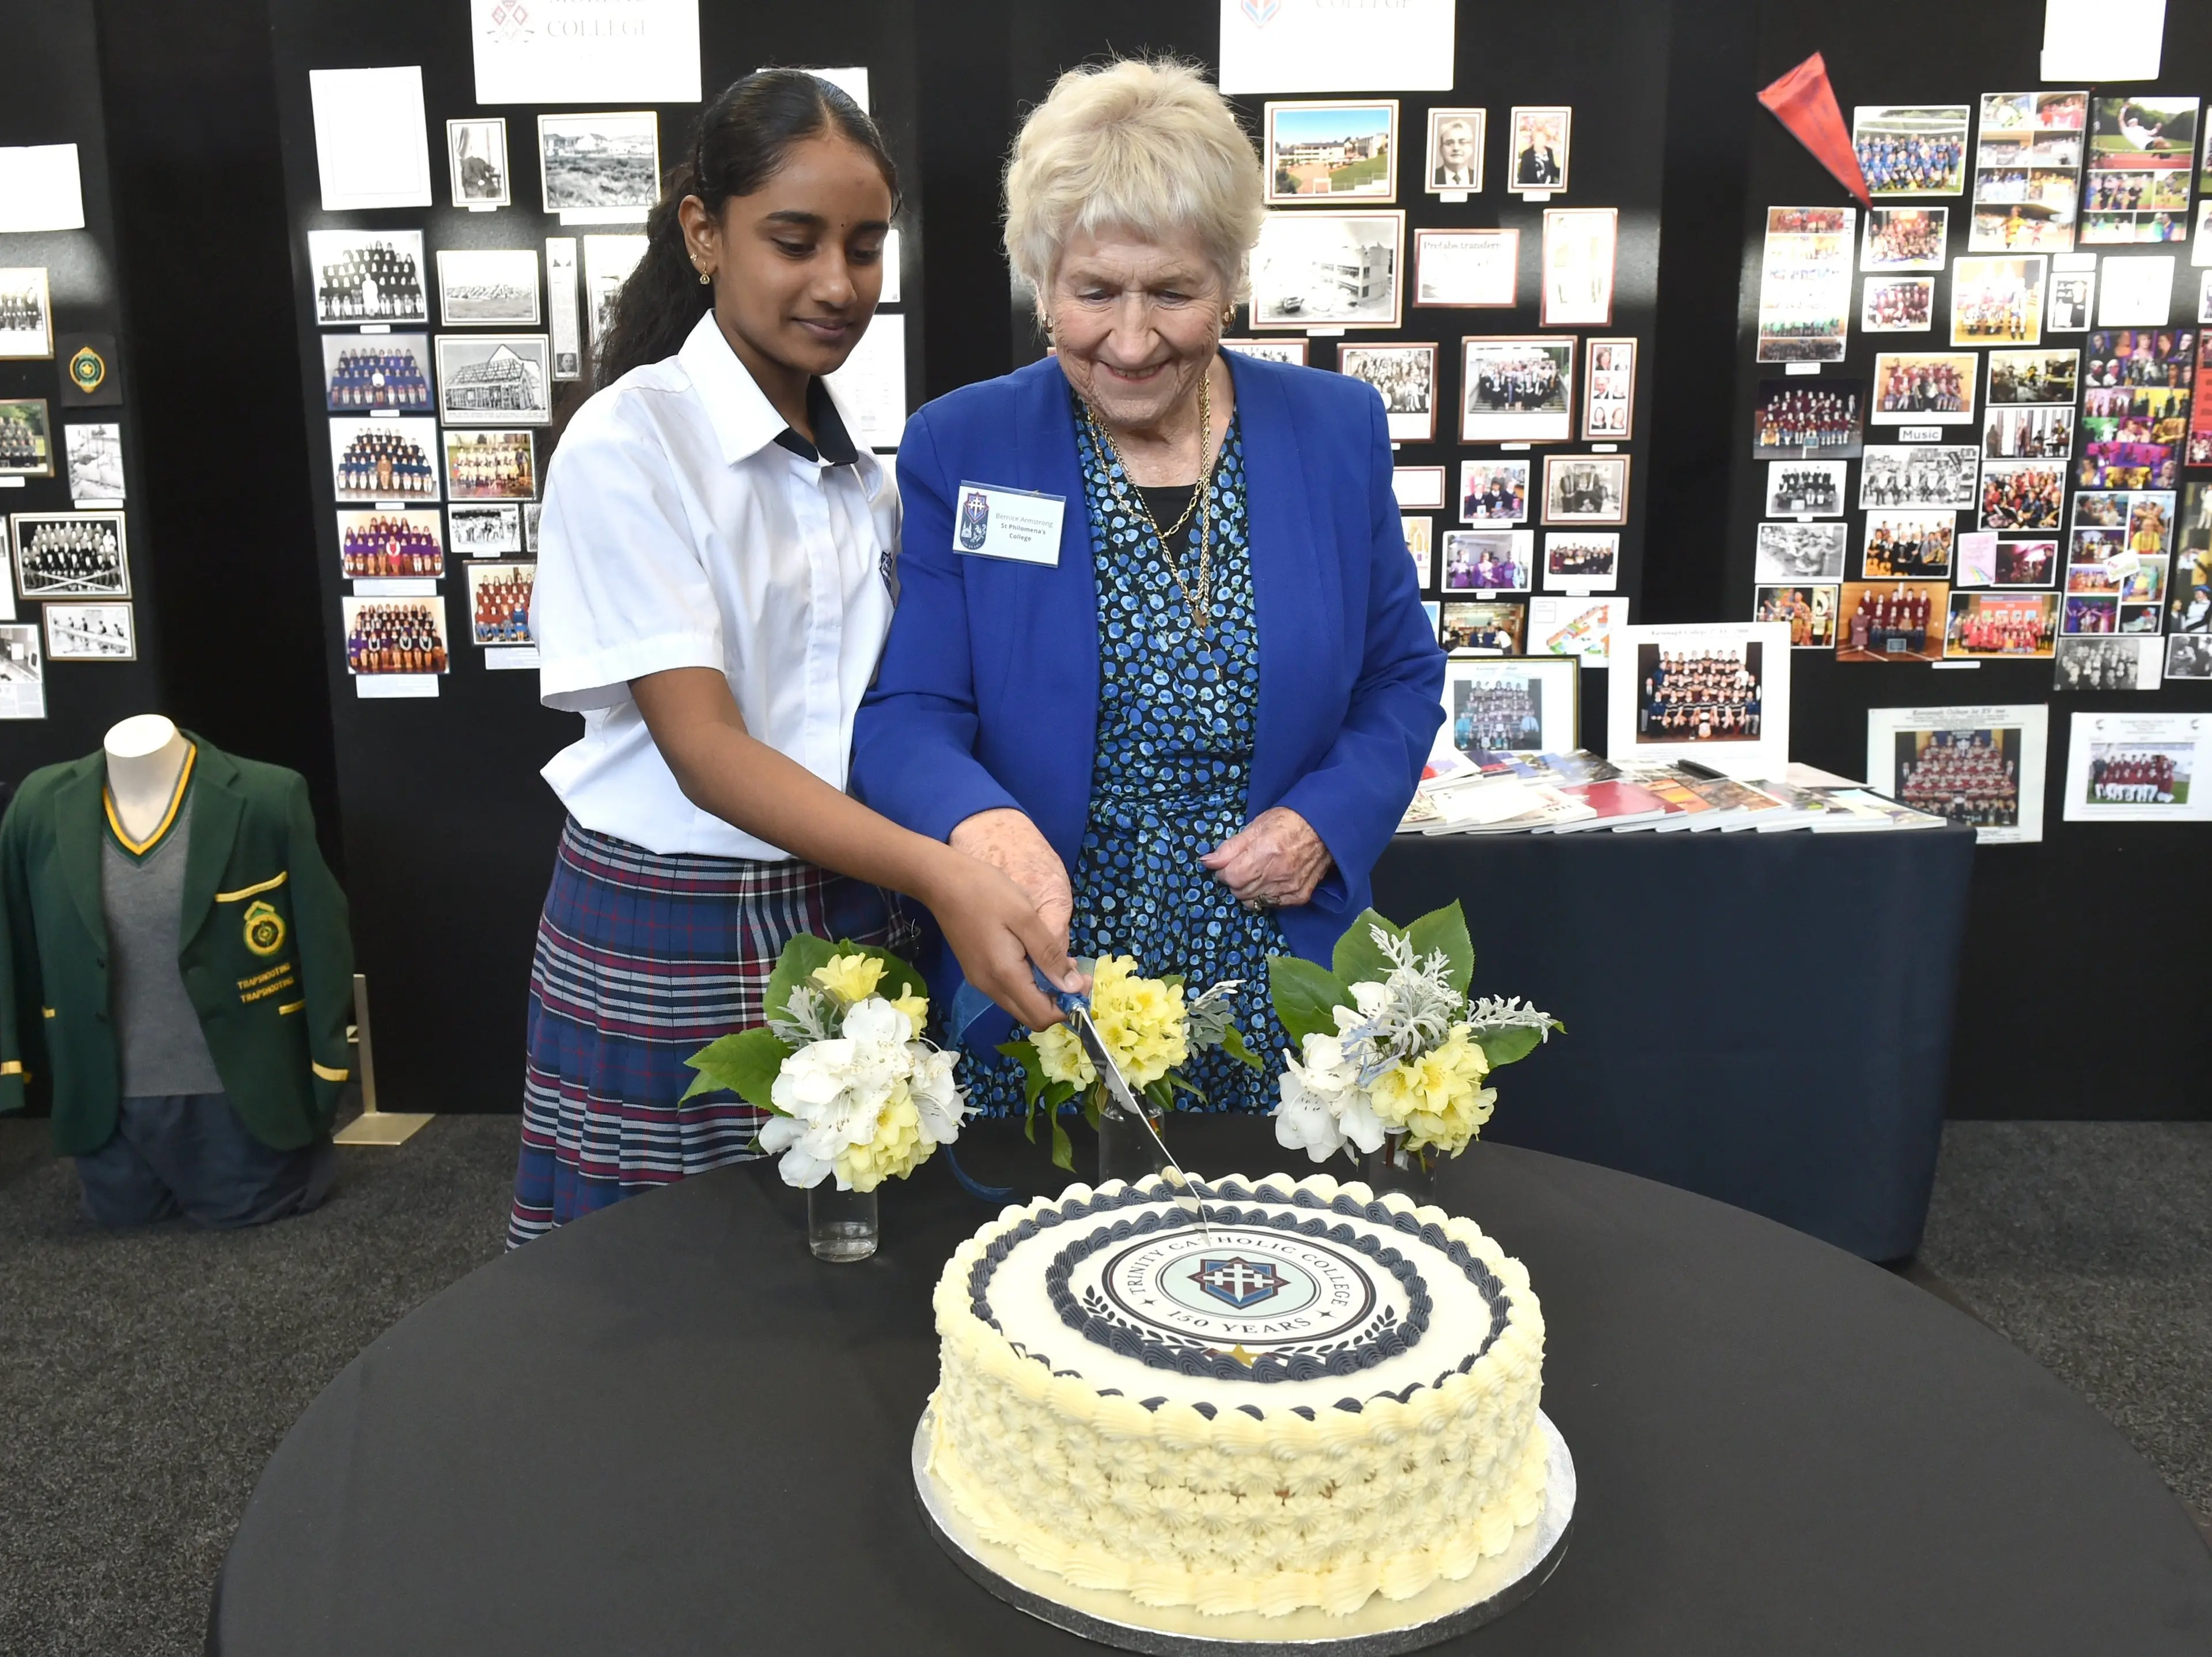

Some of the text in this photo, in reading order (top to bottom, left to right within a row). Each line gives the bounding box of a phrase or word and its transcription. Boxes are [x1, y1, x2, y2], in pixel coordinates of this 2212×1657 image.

[1903, 430, 1939, 439] Music
[995, 513, 1053, 528] Bernice Armstrong
[1009, 524, 1046, 534] Philomena's
[1009, 533, 1032, 542] College
[237, 962, 290, 990] TRAPSHOOTING
[240, 976, 294, 1003] TRAPSHOOTING
[1127, 1237, 1350, 1306] TRINITY CAHOLIC COLLEGE
[1166, 1310, 1311, 1333] 150 YEARS
